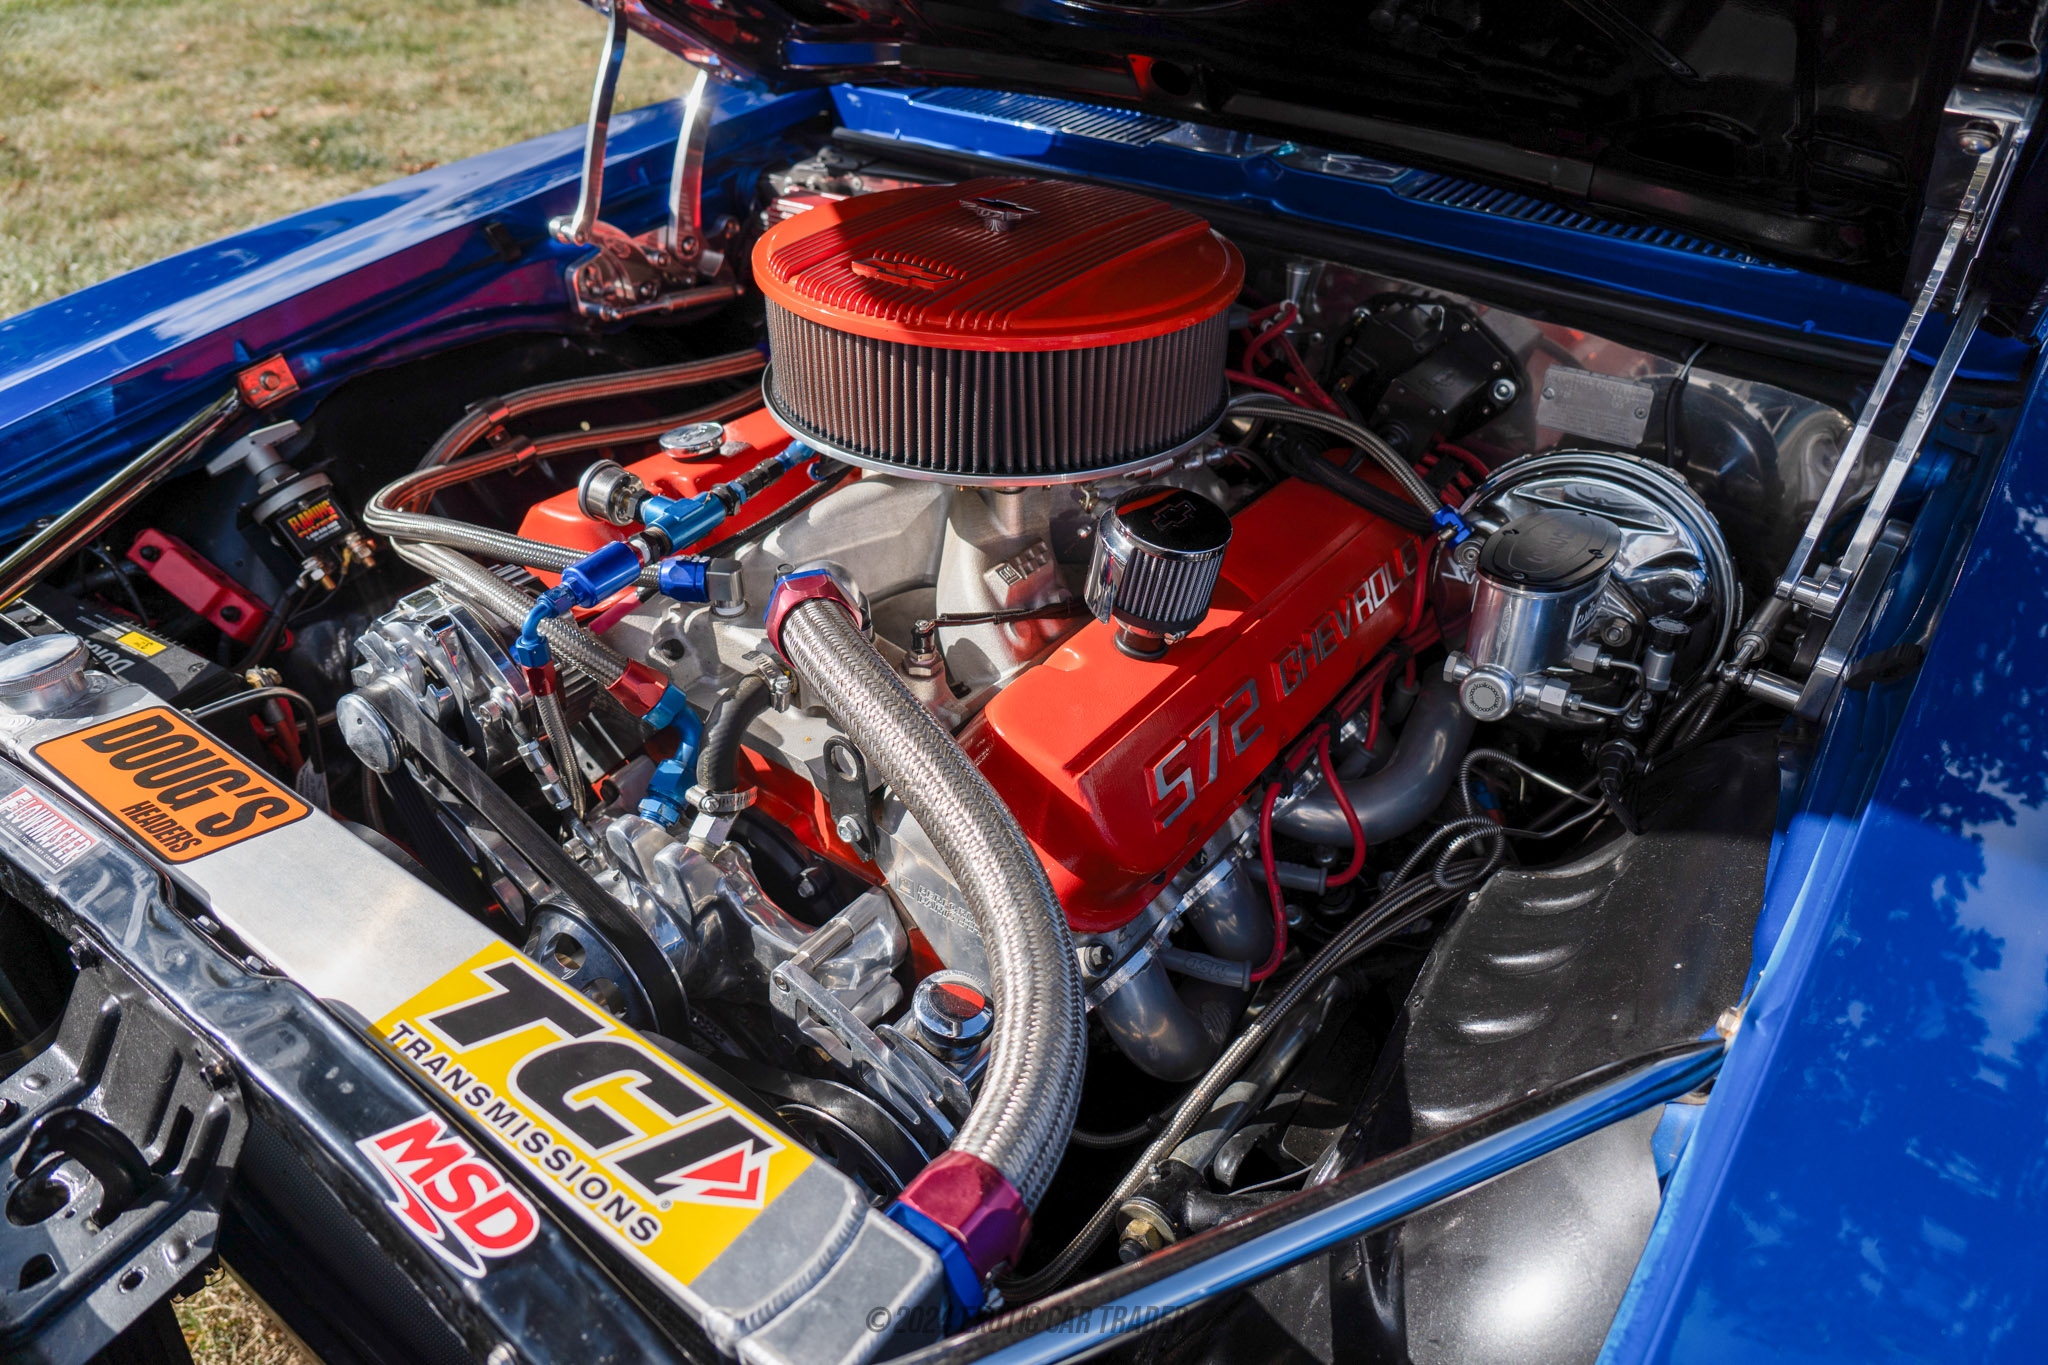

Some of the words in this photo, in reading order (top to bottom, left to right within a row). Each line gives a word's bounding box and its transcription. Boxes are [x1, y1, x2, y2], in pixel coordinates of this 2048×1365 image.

[1147, 677, 1264, 831] 572
[1273, 536, 1418, 700] CHEVROLE
[0, 791, 92, 864] FLOWMASTER
[81, 714, 290, 838] DOUG'S
[119, 800, 203, 853] HEADERS
[387, 1023, 660, 1243] TRANSMISSIONS
[420, 959, 782, 1198] TCI
[374, 1116, 537, 1250] MSD
